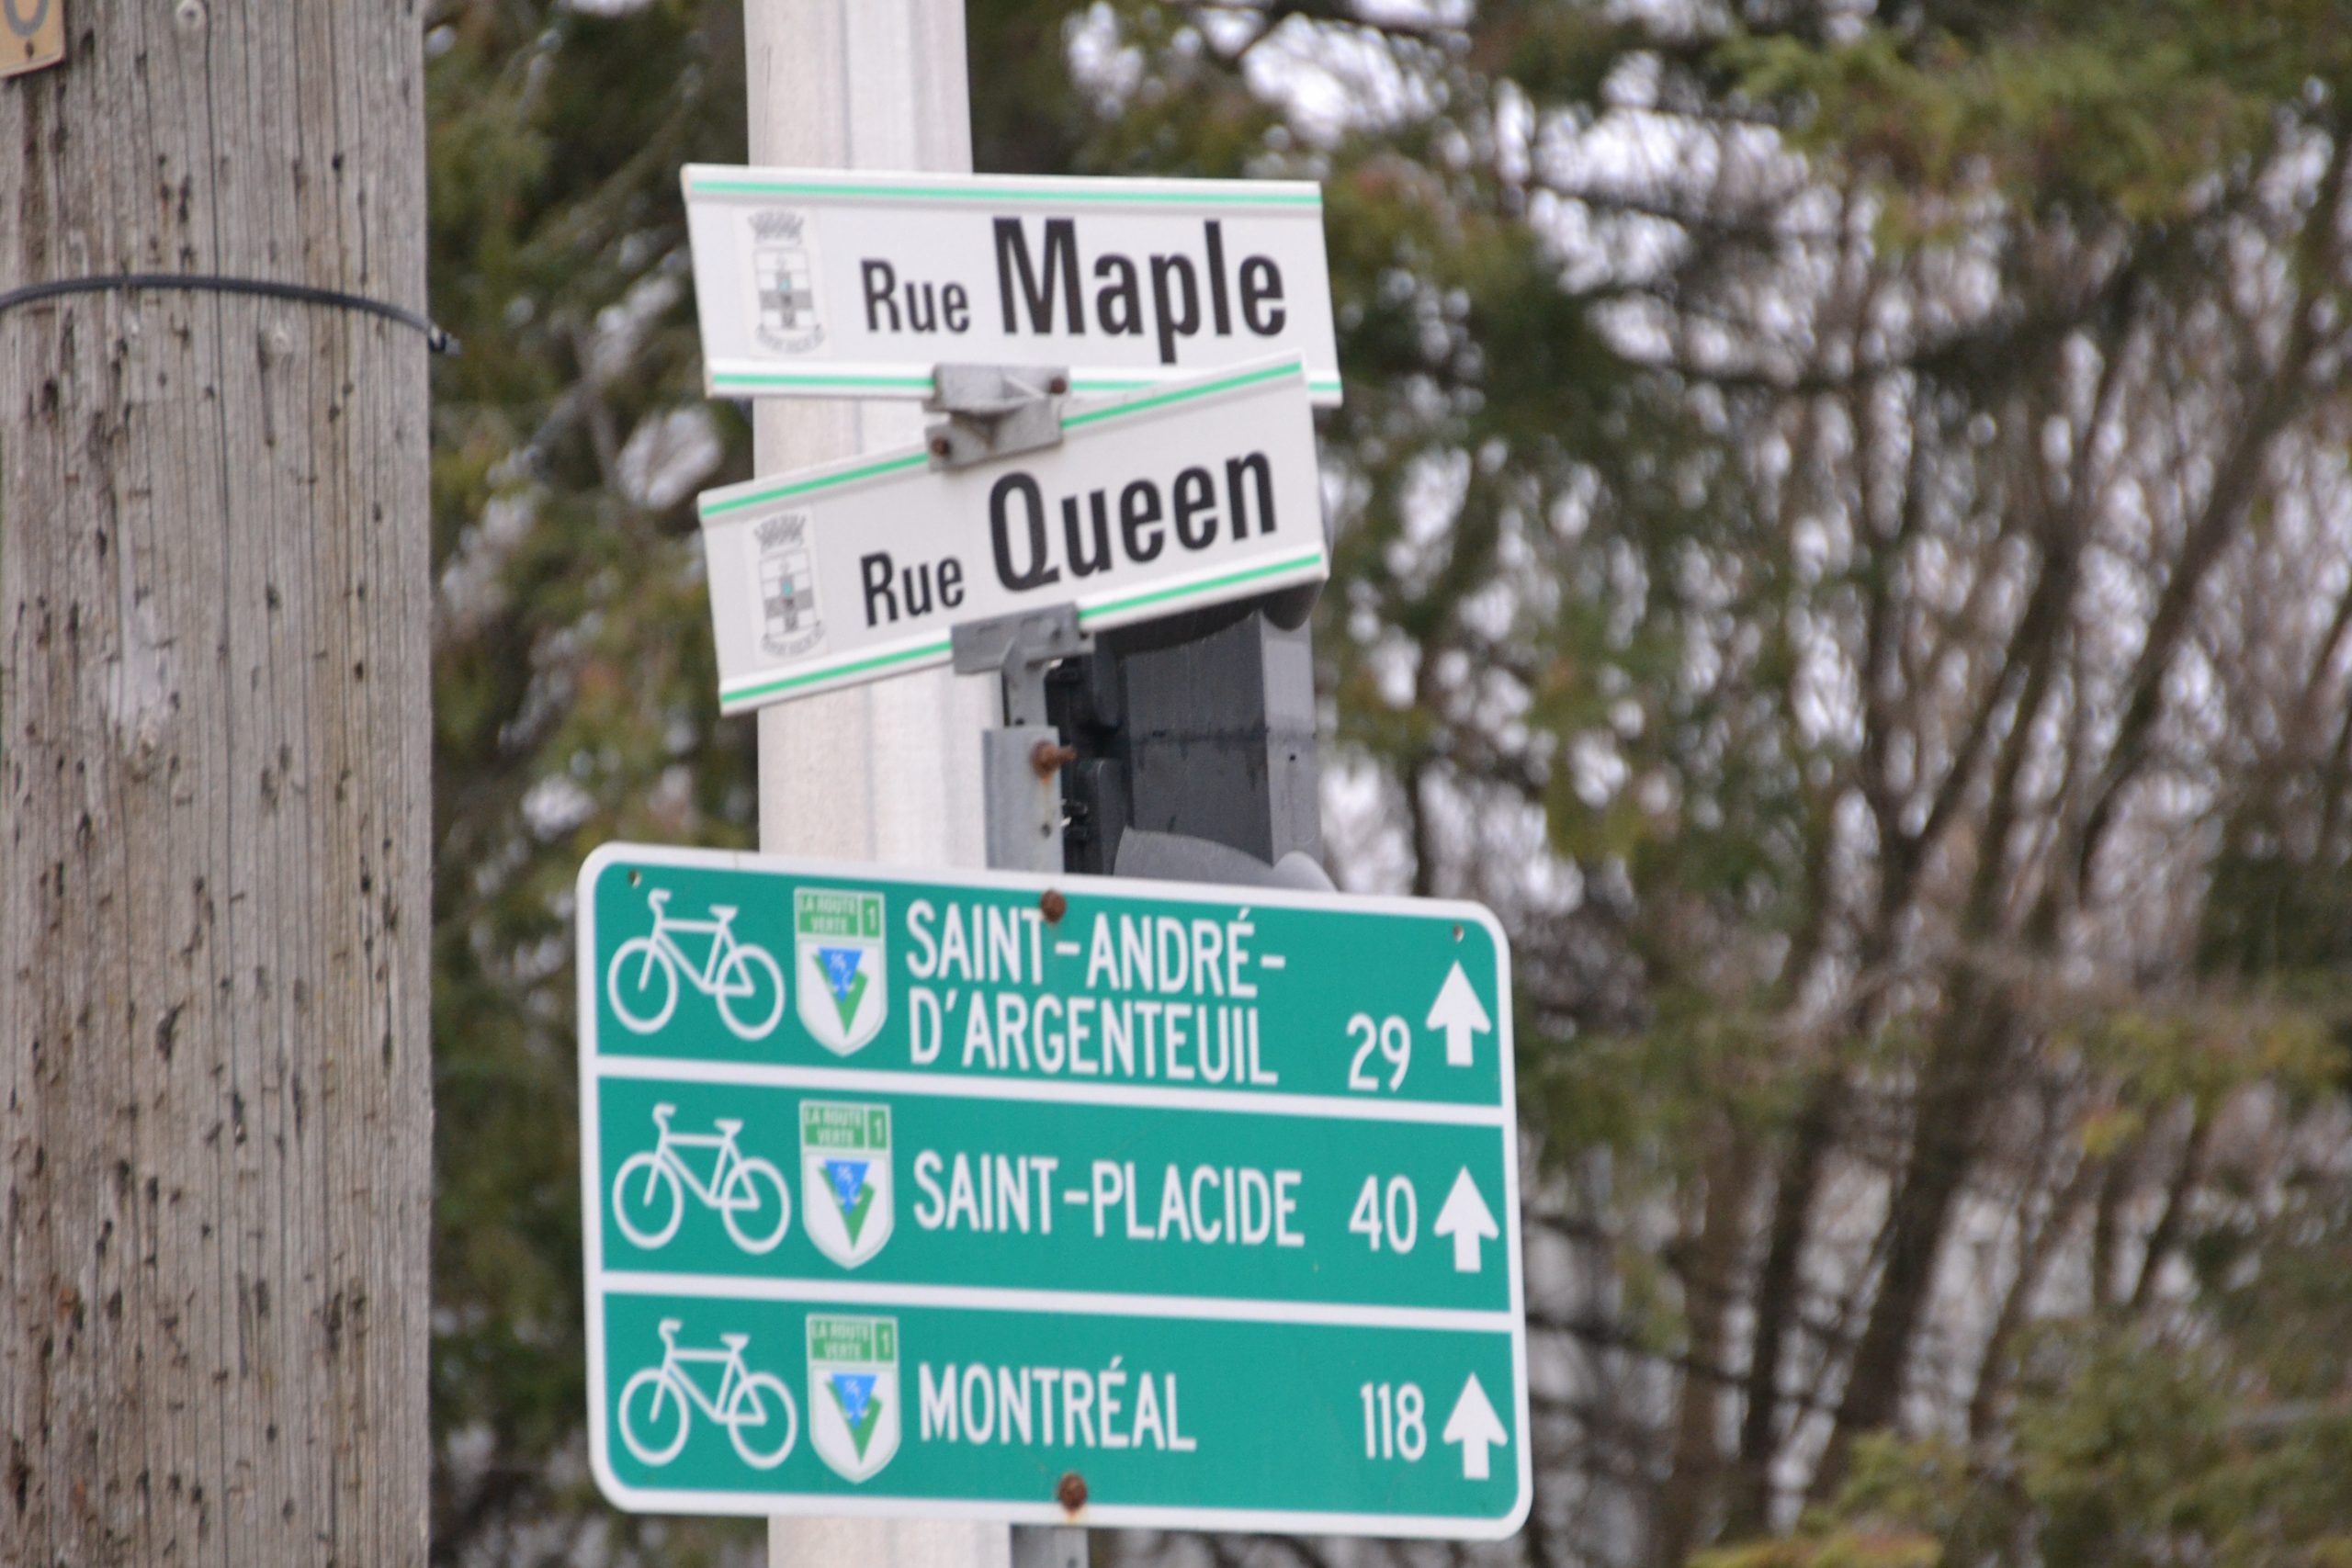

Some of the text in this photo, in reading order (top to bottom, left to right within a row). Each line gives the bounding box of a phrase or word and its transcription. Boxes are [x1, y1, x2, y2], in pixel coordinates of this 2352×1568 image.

[861, 217, 1286, 365] Rue Maple
[860, 450, 1277, 627] Rue Queen
[866, 905, 877, 932] 1
[905, 899, 1286, 998] SAINT-ANDRÉ-
[907, 987, 1279, 1086] D'ARGENTEUIL
[1345, 1012, 1412, 1092] 29
[874, 1117, 884, 1144] 1
[912, 1148, 1306, 1248] SAINT-PLACIDE
[1347, 1174, 1419, 1255] 40
[917, 1355, 1197, 1452] MONTRÉAL
[1359, 1381, 1429, 1462] 118
